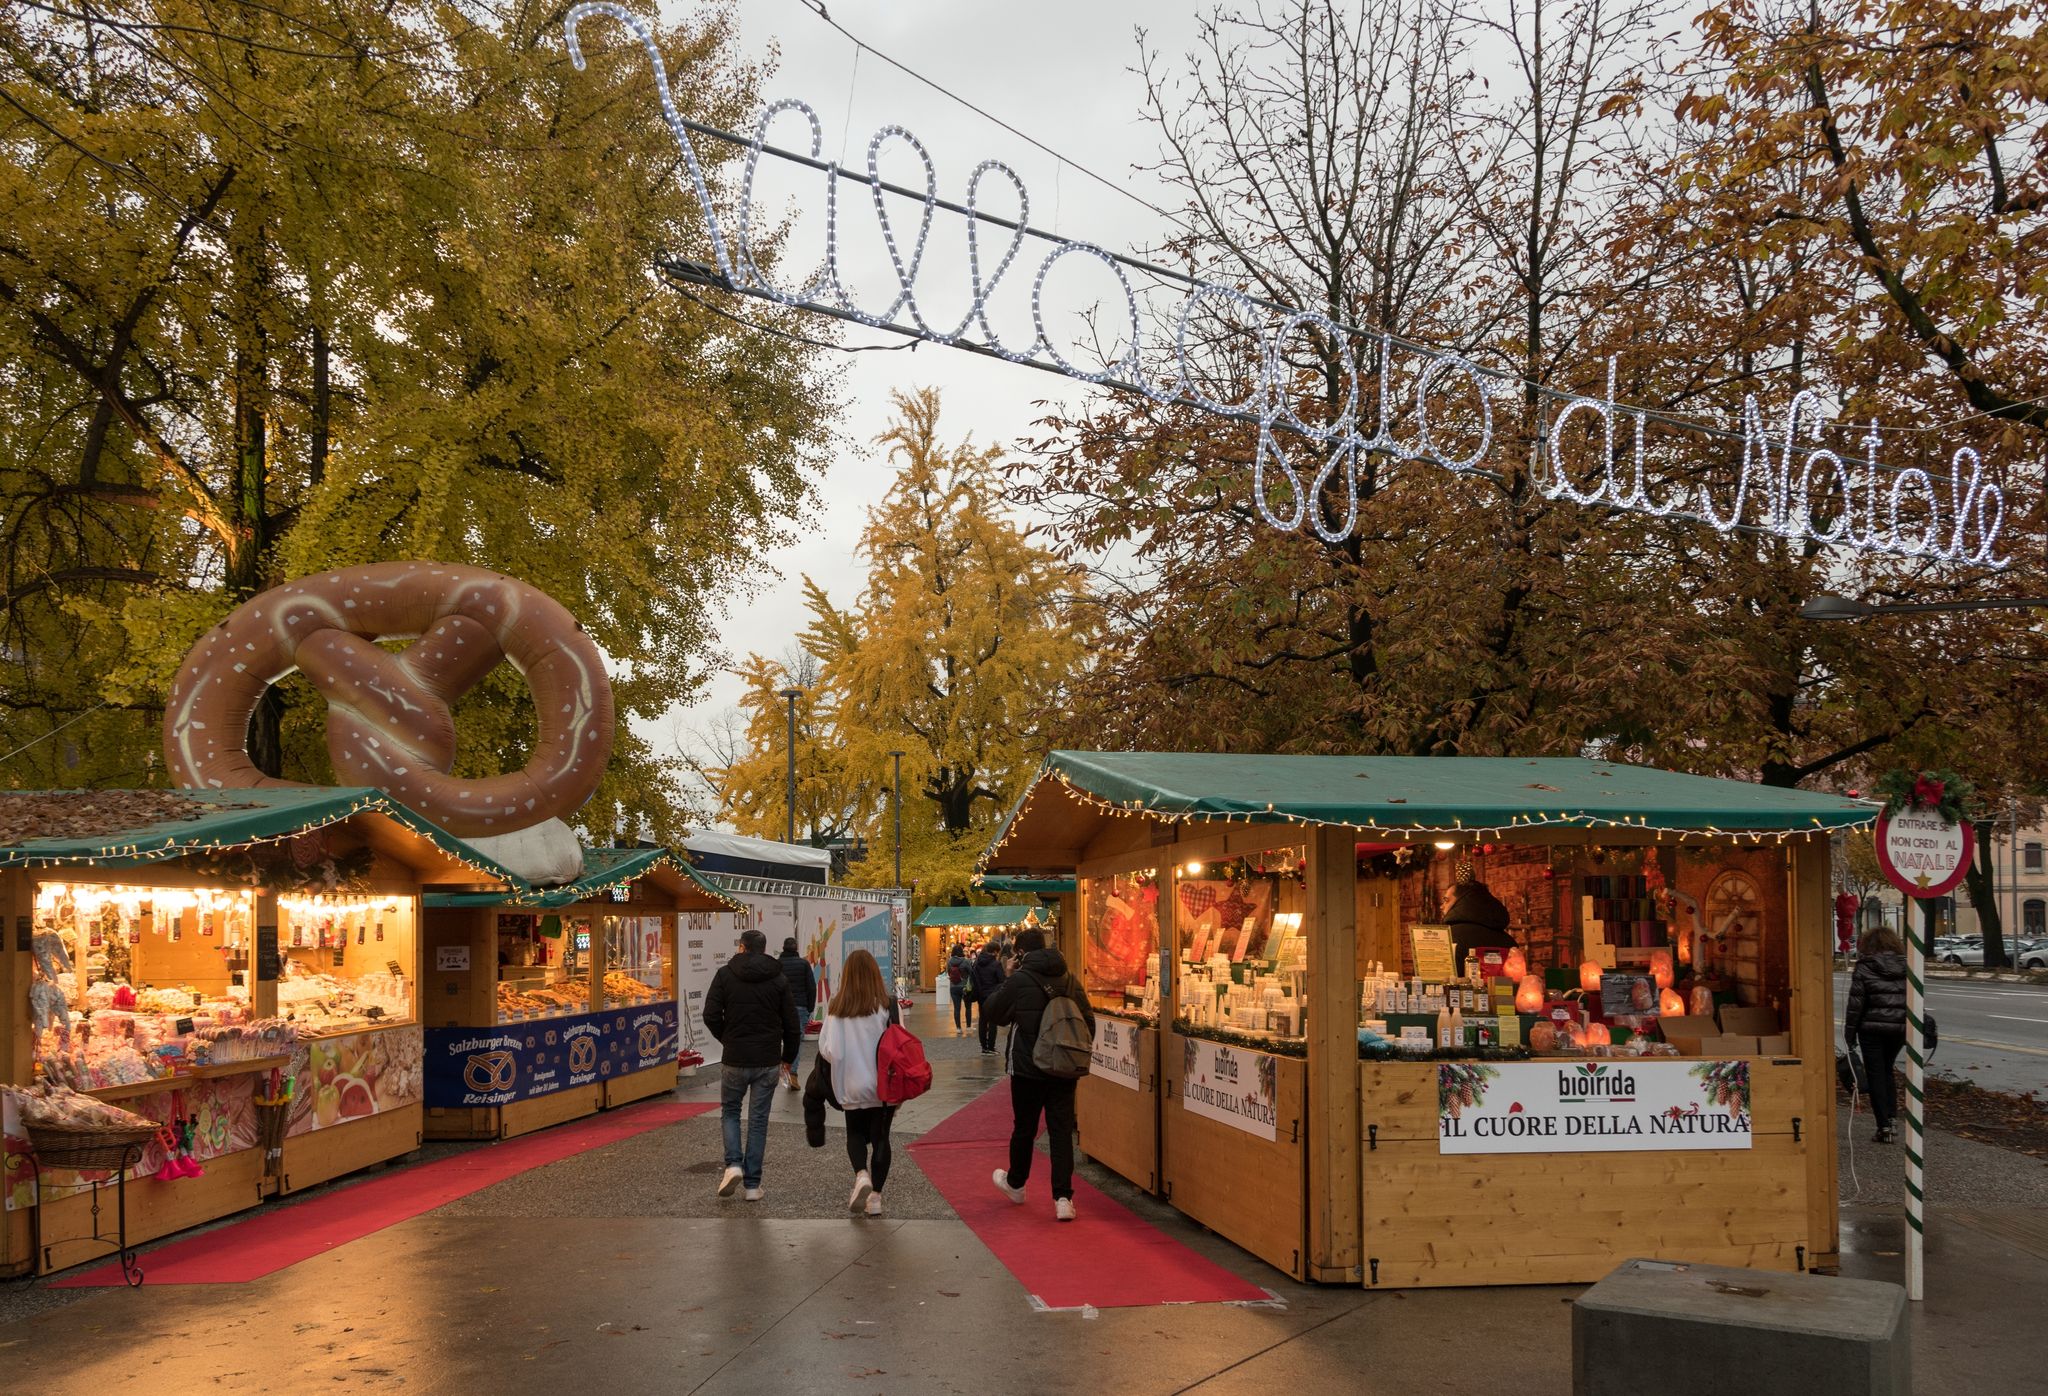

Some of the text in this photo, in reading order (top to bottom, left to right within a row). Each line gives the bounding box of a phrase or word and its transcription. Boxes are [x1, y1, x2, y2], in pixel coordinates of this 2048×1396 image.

[564, 1, 2011, 570] Villaggio di Natale
[1898, 819, 1950, 832] ENTRARE SE
[1891, 836, 1958, 850] NON CREDI AL
[1894, 851, 1955, 870] NATALE
[449, 1035, 523, 1055] Salzburger Brezen
[1104, 1055, 1119, 1073] DELLA
[1214, 1050, 1238, 1078] bioirida
[570, 1072, 596, 1085] Reisinger
[1559, 1069, 1636, 1096] bioirida
[463, 1091, 516, 1104] Reisinger
[1184, 1081, 1276, 1126] IL CUORE DELLA NATURA
[1443, 1113, 1751, 1137] IL CUORE DELLA NATURA
